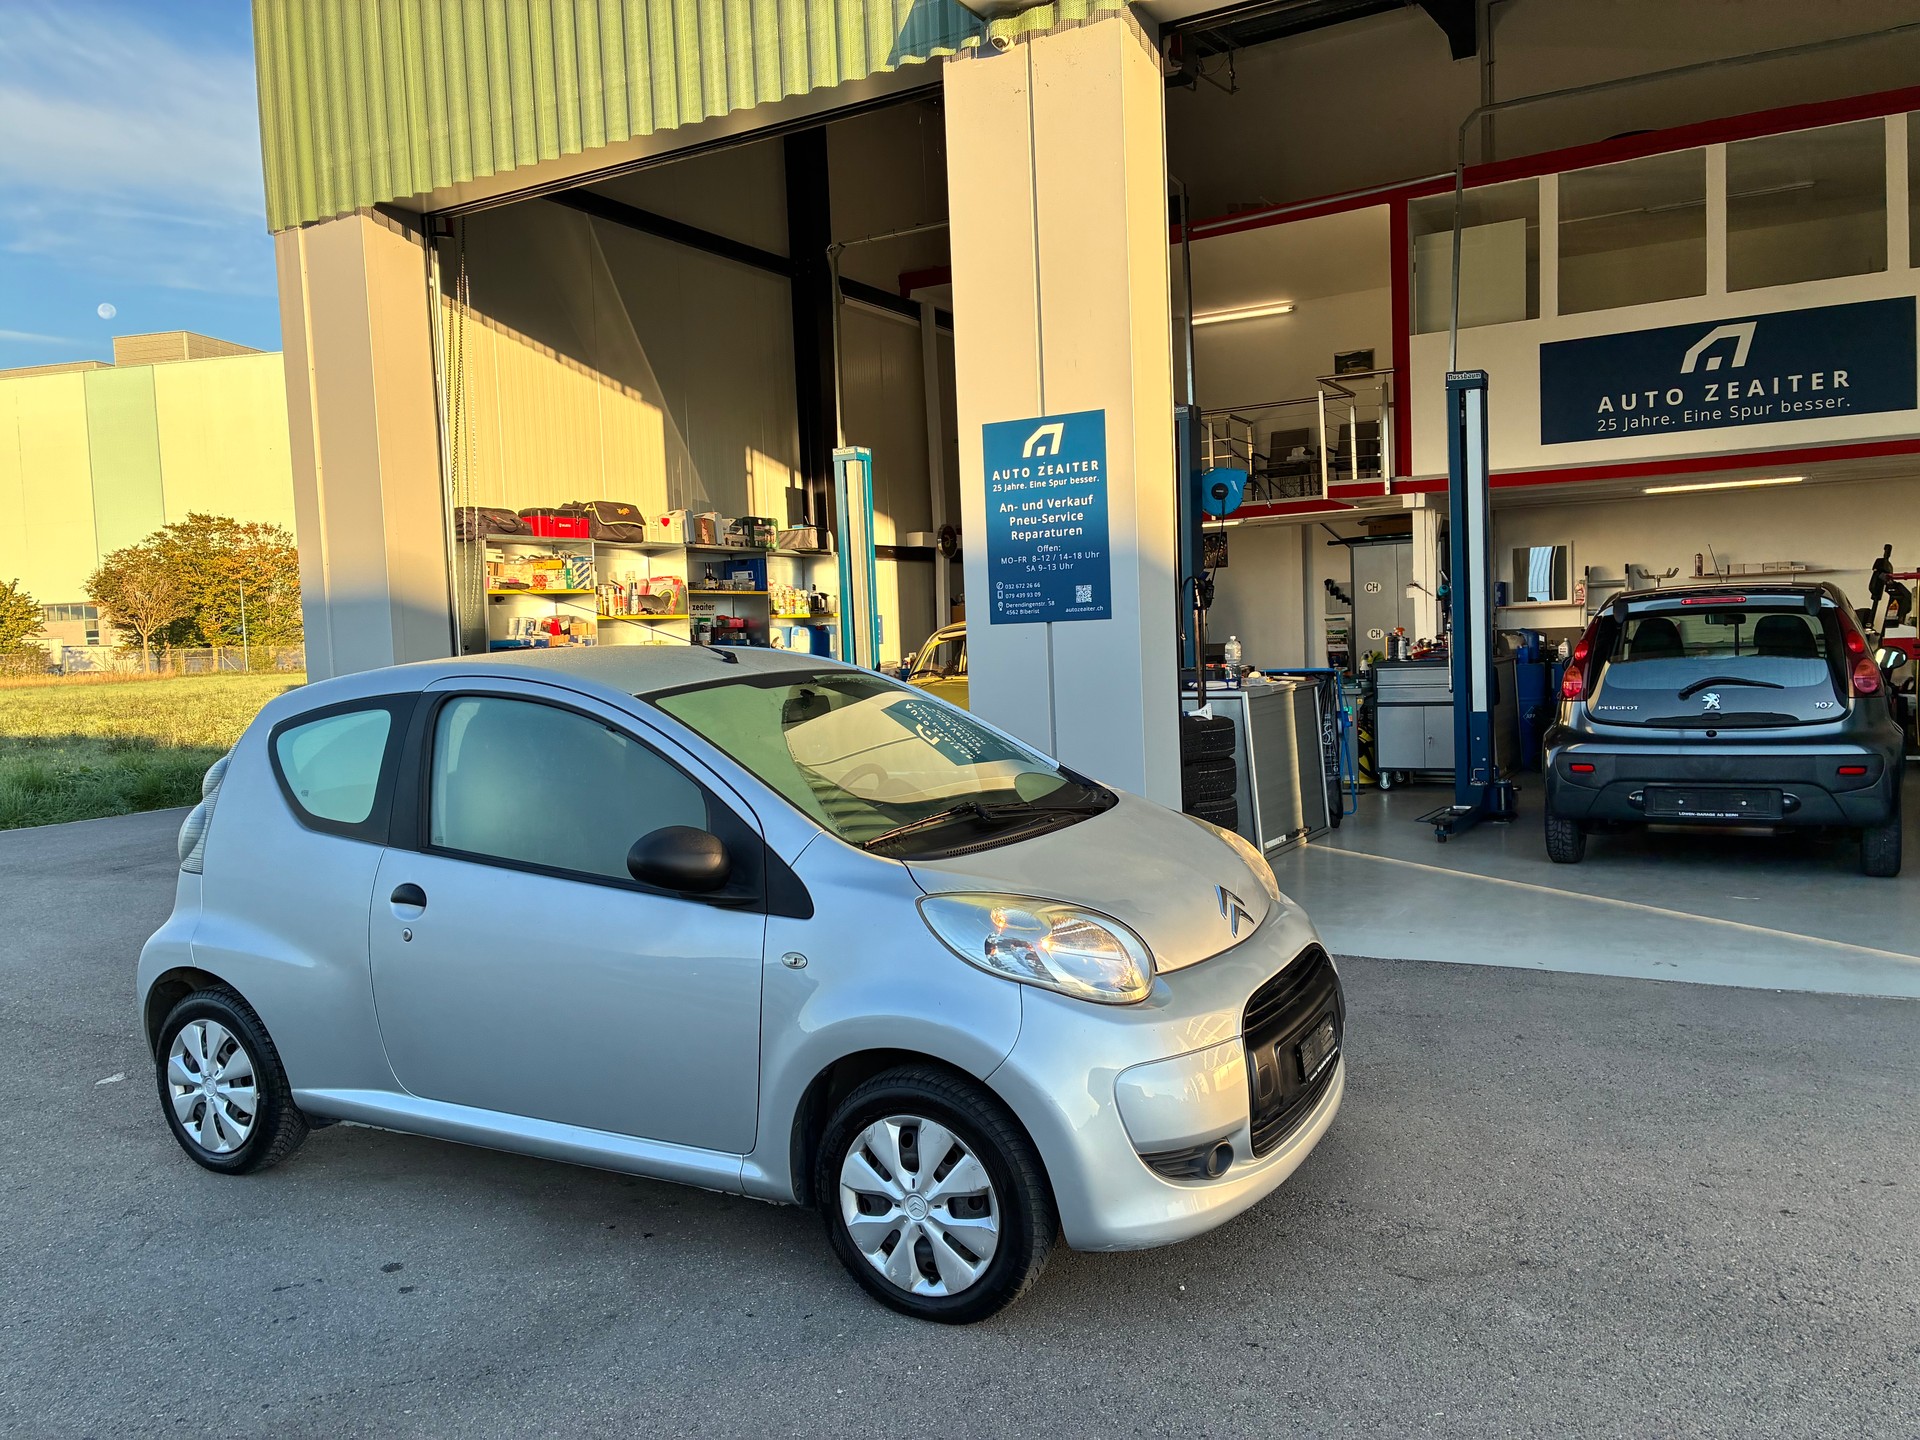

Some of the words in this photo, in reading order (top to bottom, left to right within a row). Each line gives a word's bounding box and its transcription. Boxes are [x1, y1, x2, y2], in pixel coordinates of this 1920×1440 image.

[1597, 388, 1684, 414] AUTO
[1705, 370, 1850, 402] ZEAITER
[1597, 419, 1617, 432] 25
[1623, 414, 1676, 432] Jahre.
[1684, 410, 1722, 424] Eine
[1729, 404, 1773, 422] Spur
[1781, 396, 1850, 414] besser.
[992, 468, 1030, 480] AUTO
[1038, 460, 1098, 476] ZEAITER
[992, 484, 1002, 492] 25
[1004, 482, 1027, 492] Jahre.
[1030, 480, 1046, 488] Eine
[1048, 478, 1067, 488] Spur
[1070, 476, 1100, 484] besser.
[1000, 502, 1018, 513] An-
[1022, 499, 1043, 511] und
[1047, 494, 1094, 508] Verkauf
[1010, 512, 1084, 526] Pneu-Service
[1011, 527, 1083, 542] Reparaturen
[1366, 583, 1378, 592] CH
[1371, 630, 1380, 638] CH
